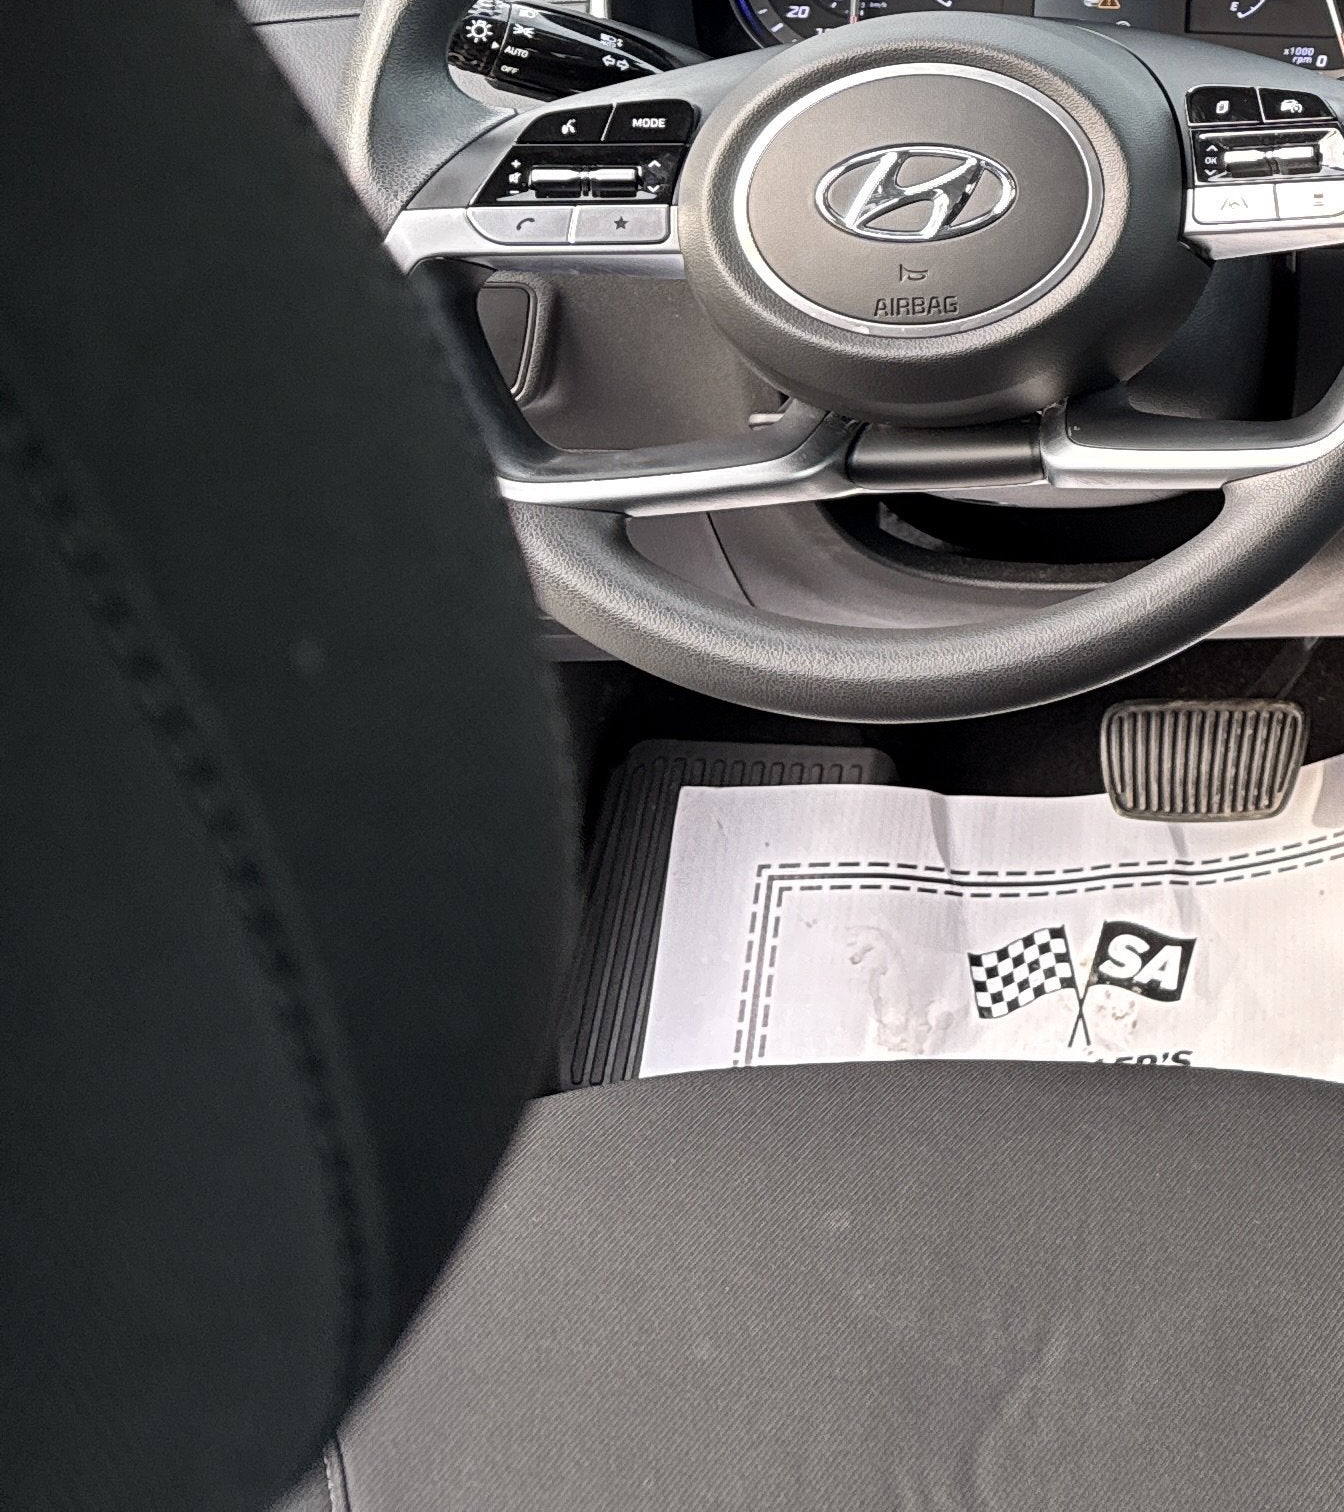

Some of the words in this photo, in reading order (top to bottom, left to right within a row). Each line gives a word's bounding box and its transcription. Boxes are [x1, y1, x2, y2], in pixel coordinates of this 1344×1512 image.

[786, 5, 810, 19] 20
[1229, 2, 1239, 12] E
[504, 45, 529, 59] AUTO
[1292, 55, 1312, 64] rpm
[1315, 55, 1328, 67] 0
[500, 65, 519, 75] OFF
[632, 117, 666, 129] MODE
[1204, 156, 1218, 165] OK
[873, 296, 960, 317] AIRBAG
[1098, 933, 1182, 990] SA
